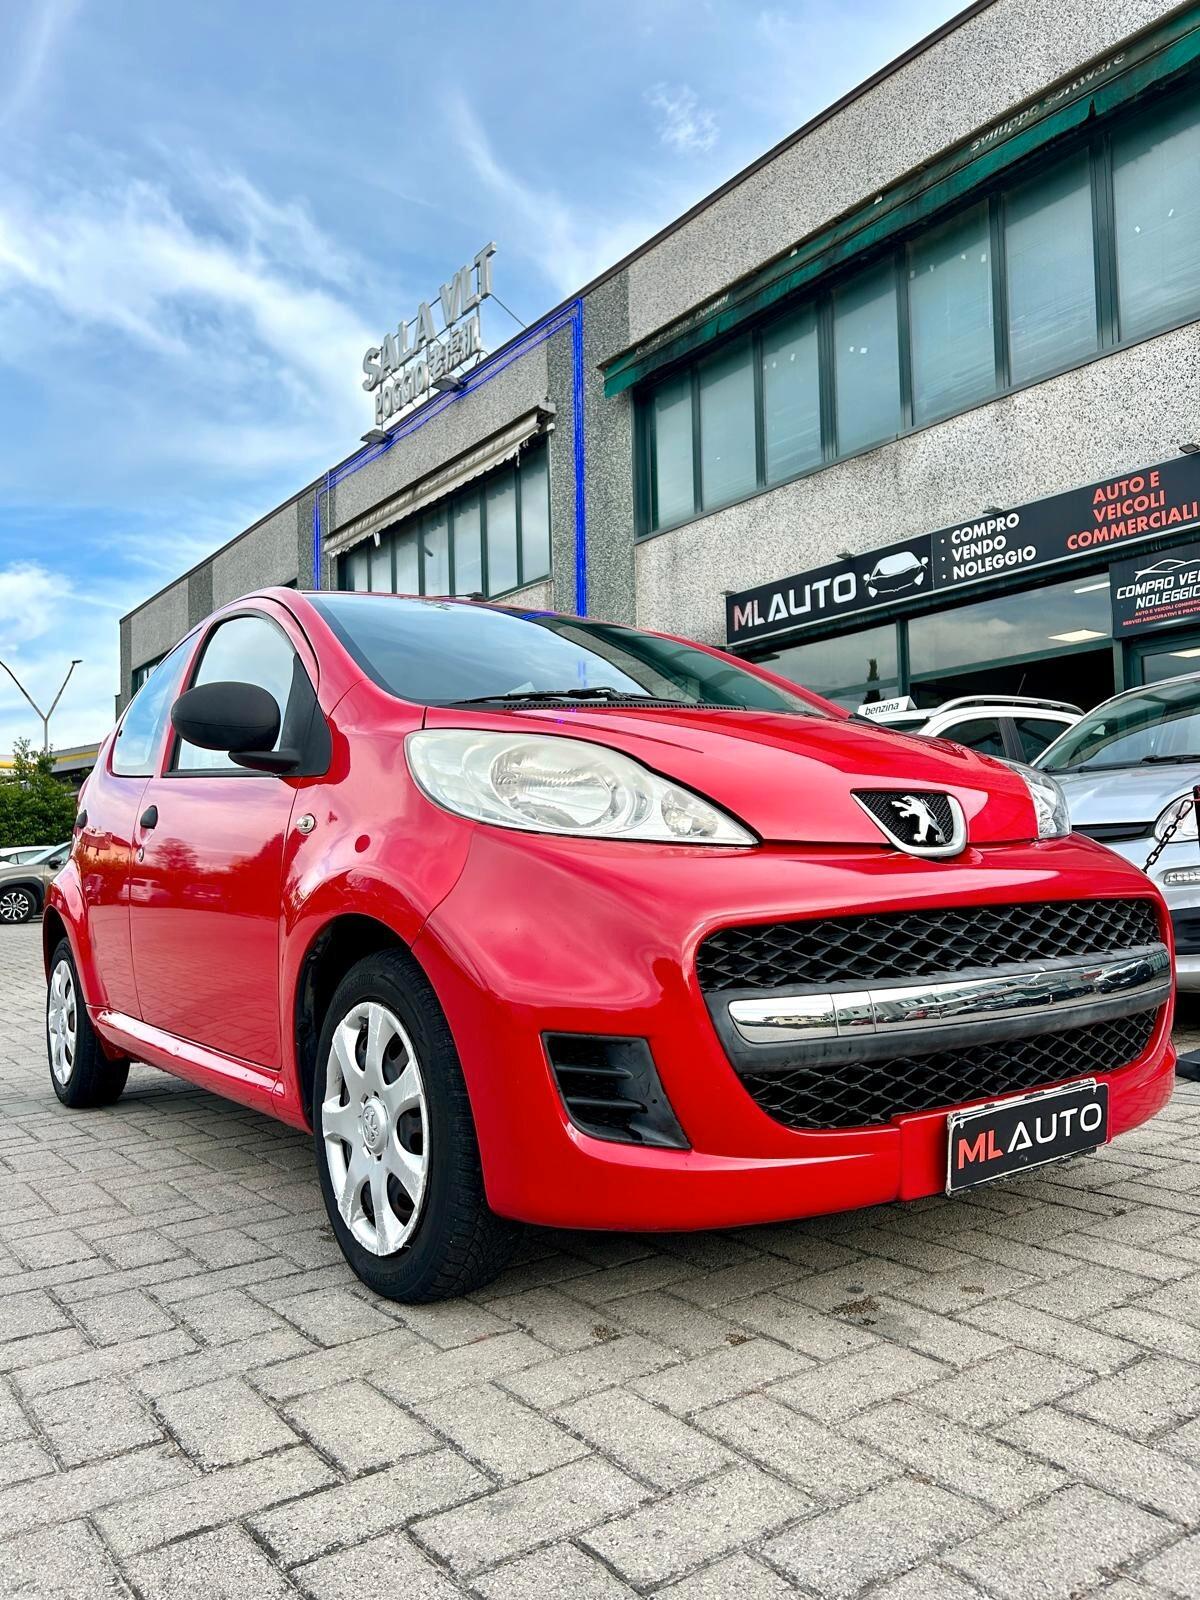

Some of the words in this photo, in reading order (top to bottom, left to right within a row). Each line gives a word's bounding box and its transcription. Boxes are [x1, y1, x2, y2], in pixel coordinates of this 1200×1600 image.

[362, 302, 435, 392] SALA
[439, 241, 497, 328] VLT
[375, 361, 430, 426] POGGIO
[1093, 476, 1145, 505] AUTO
[1150, 471, 1160, 488] E
[1093, 490, 1165, 523] VEICOLI
[951, 512, 1020, 545] COMPRO
[1067, 501, 1198, 550] COMMERCIALI
[951, 535, 1007, 562] VENDO
[953, 545, 1037, 580] NOLEGGIO
[1116, 576, 1175, 600] COMPRO
[1135, 609, 1149, 617] AUTO
[1154, 604, 1174, 613] VEICOLI
[865, 702, 900, 715] benzina
